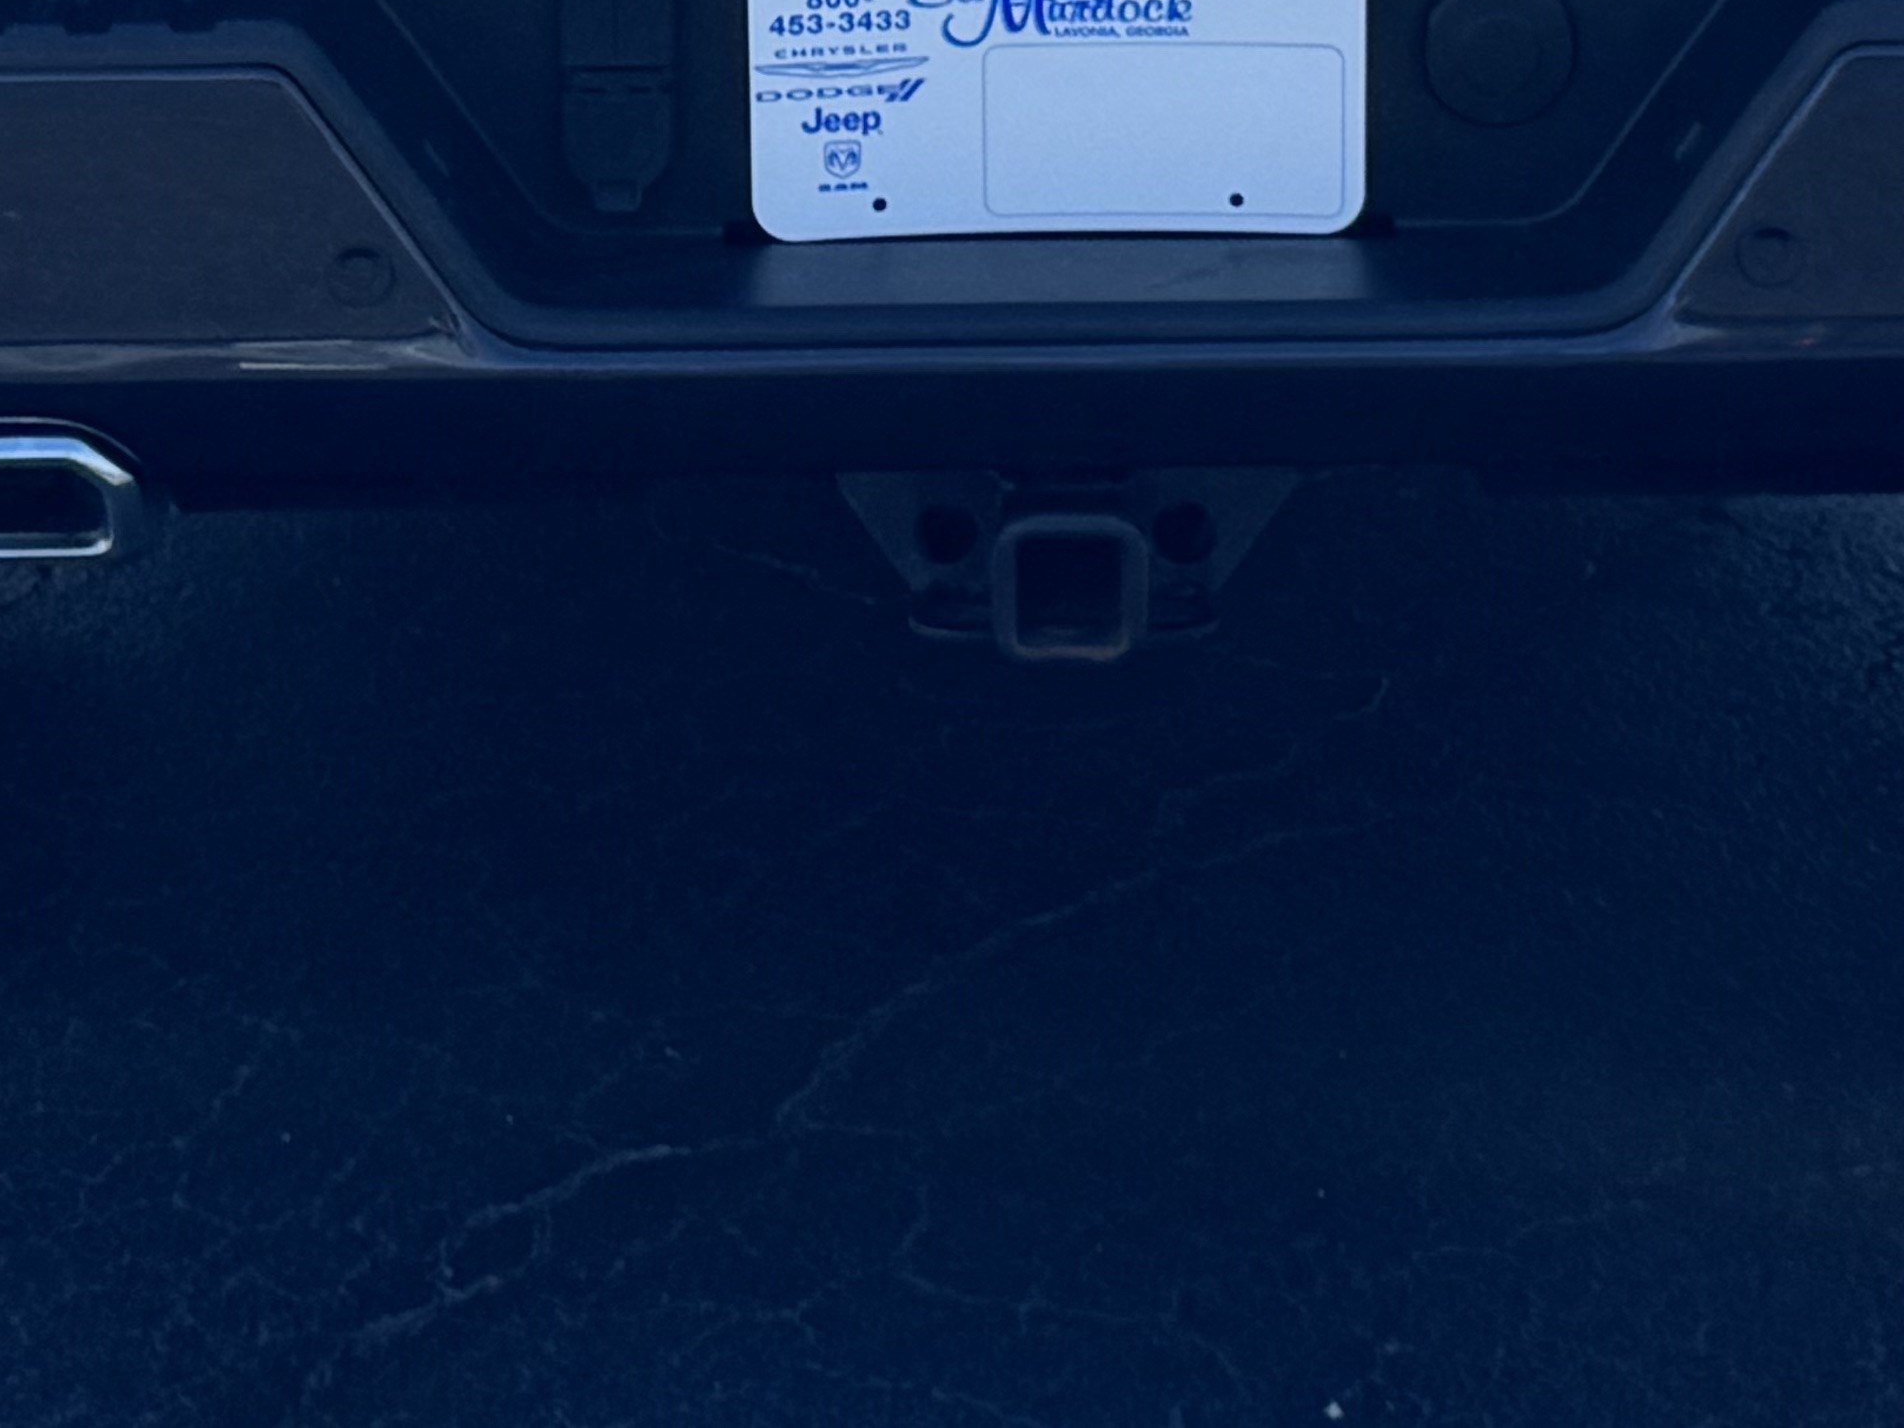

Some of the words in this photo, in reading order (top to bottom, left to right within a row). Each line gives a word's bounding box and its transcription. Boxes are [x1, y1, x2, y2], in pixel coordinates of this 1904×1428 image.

[768, 9, 912, 36] 453-3433
[1126, 25, 1189, 37] GEORGIA
[773, 42, 908, 60] CHRYSLER
[755, 83, 904, 103] DODGE
[801, 106, 881, 136] Jeep
